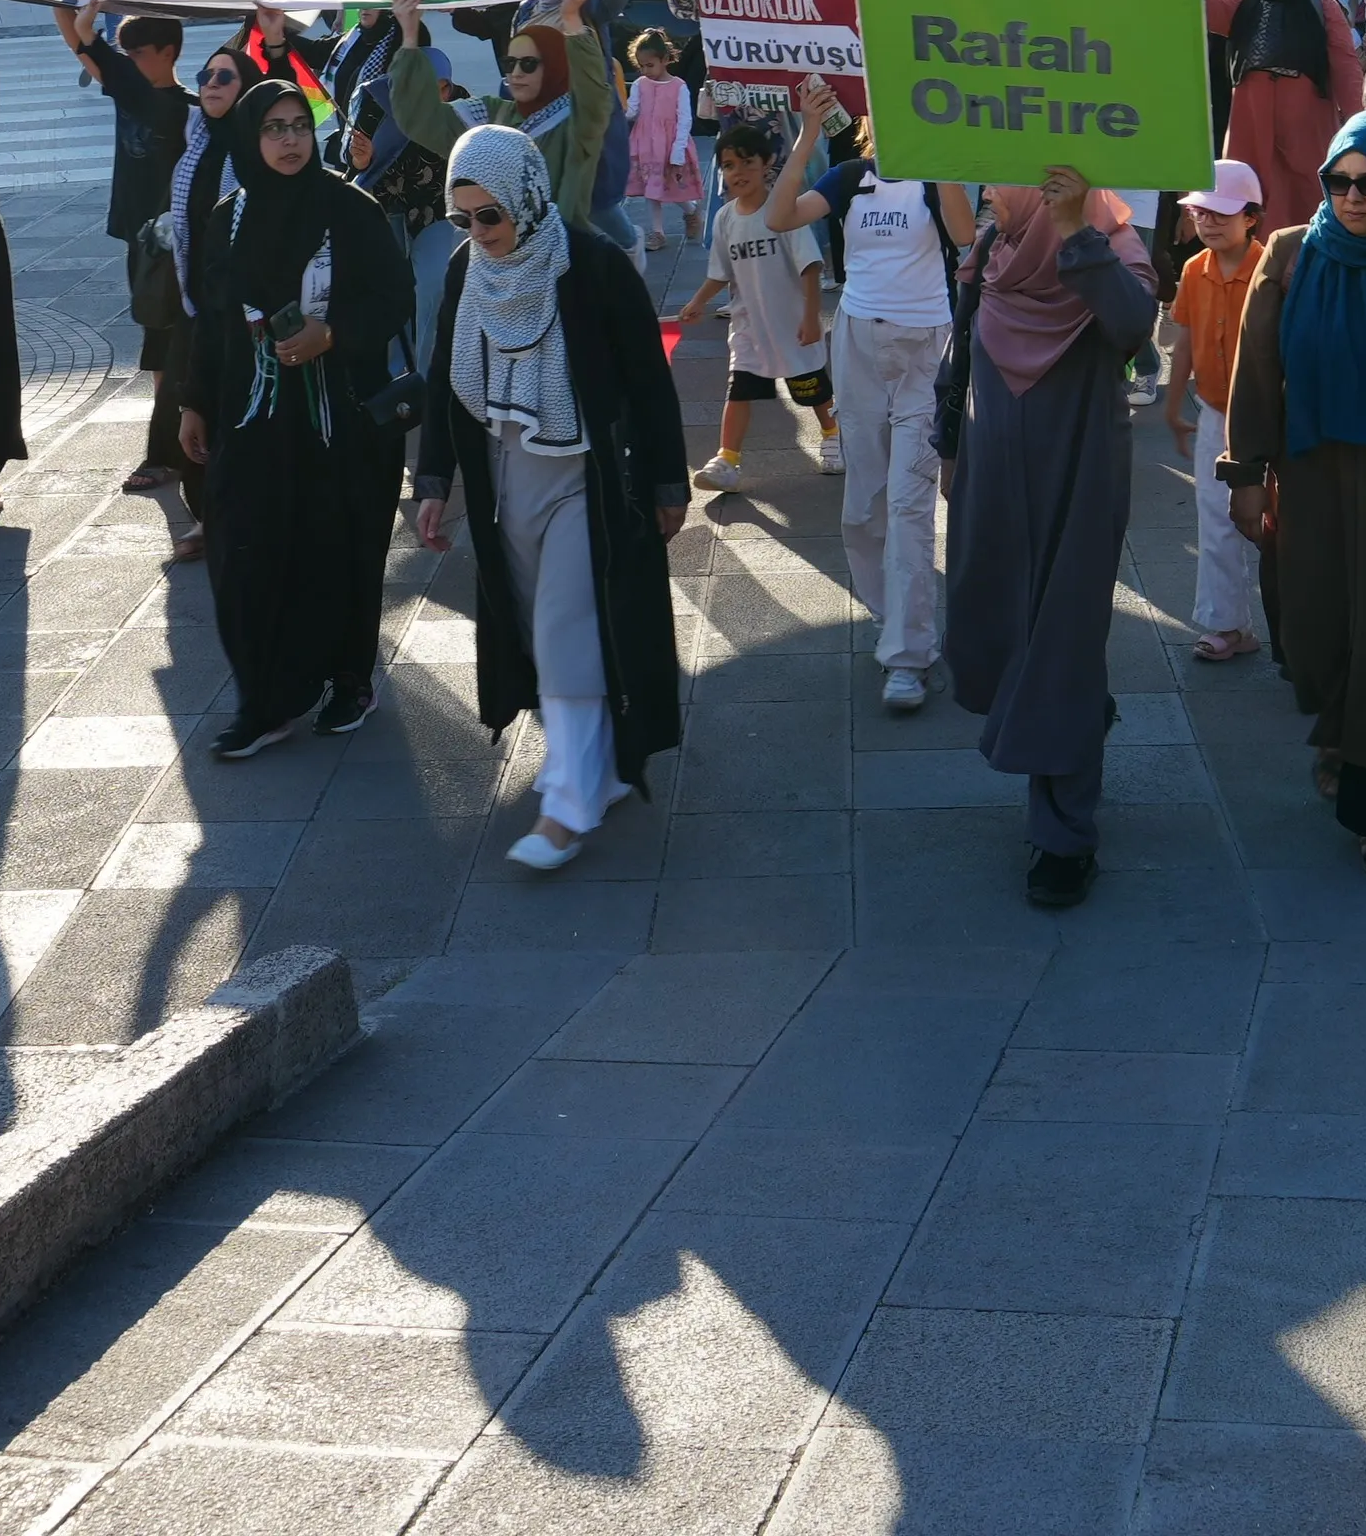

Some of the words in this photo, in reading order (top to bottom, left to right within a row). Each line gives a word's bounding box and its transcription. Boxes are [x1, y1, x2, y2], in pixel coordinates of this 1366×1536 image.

[704, 35, 863, 72] YÜRÜYÜŞÜ
[912, 15, 1112, 75] Rafah
[747, 83, 789, 94] KASTAMONU
[748, 92, 790, 113] İHH
[912, 78, 1140, 138] OnFire
[860, 211, 909, 229] ATLANTA
[730, 238, 778, 261] SWEET
